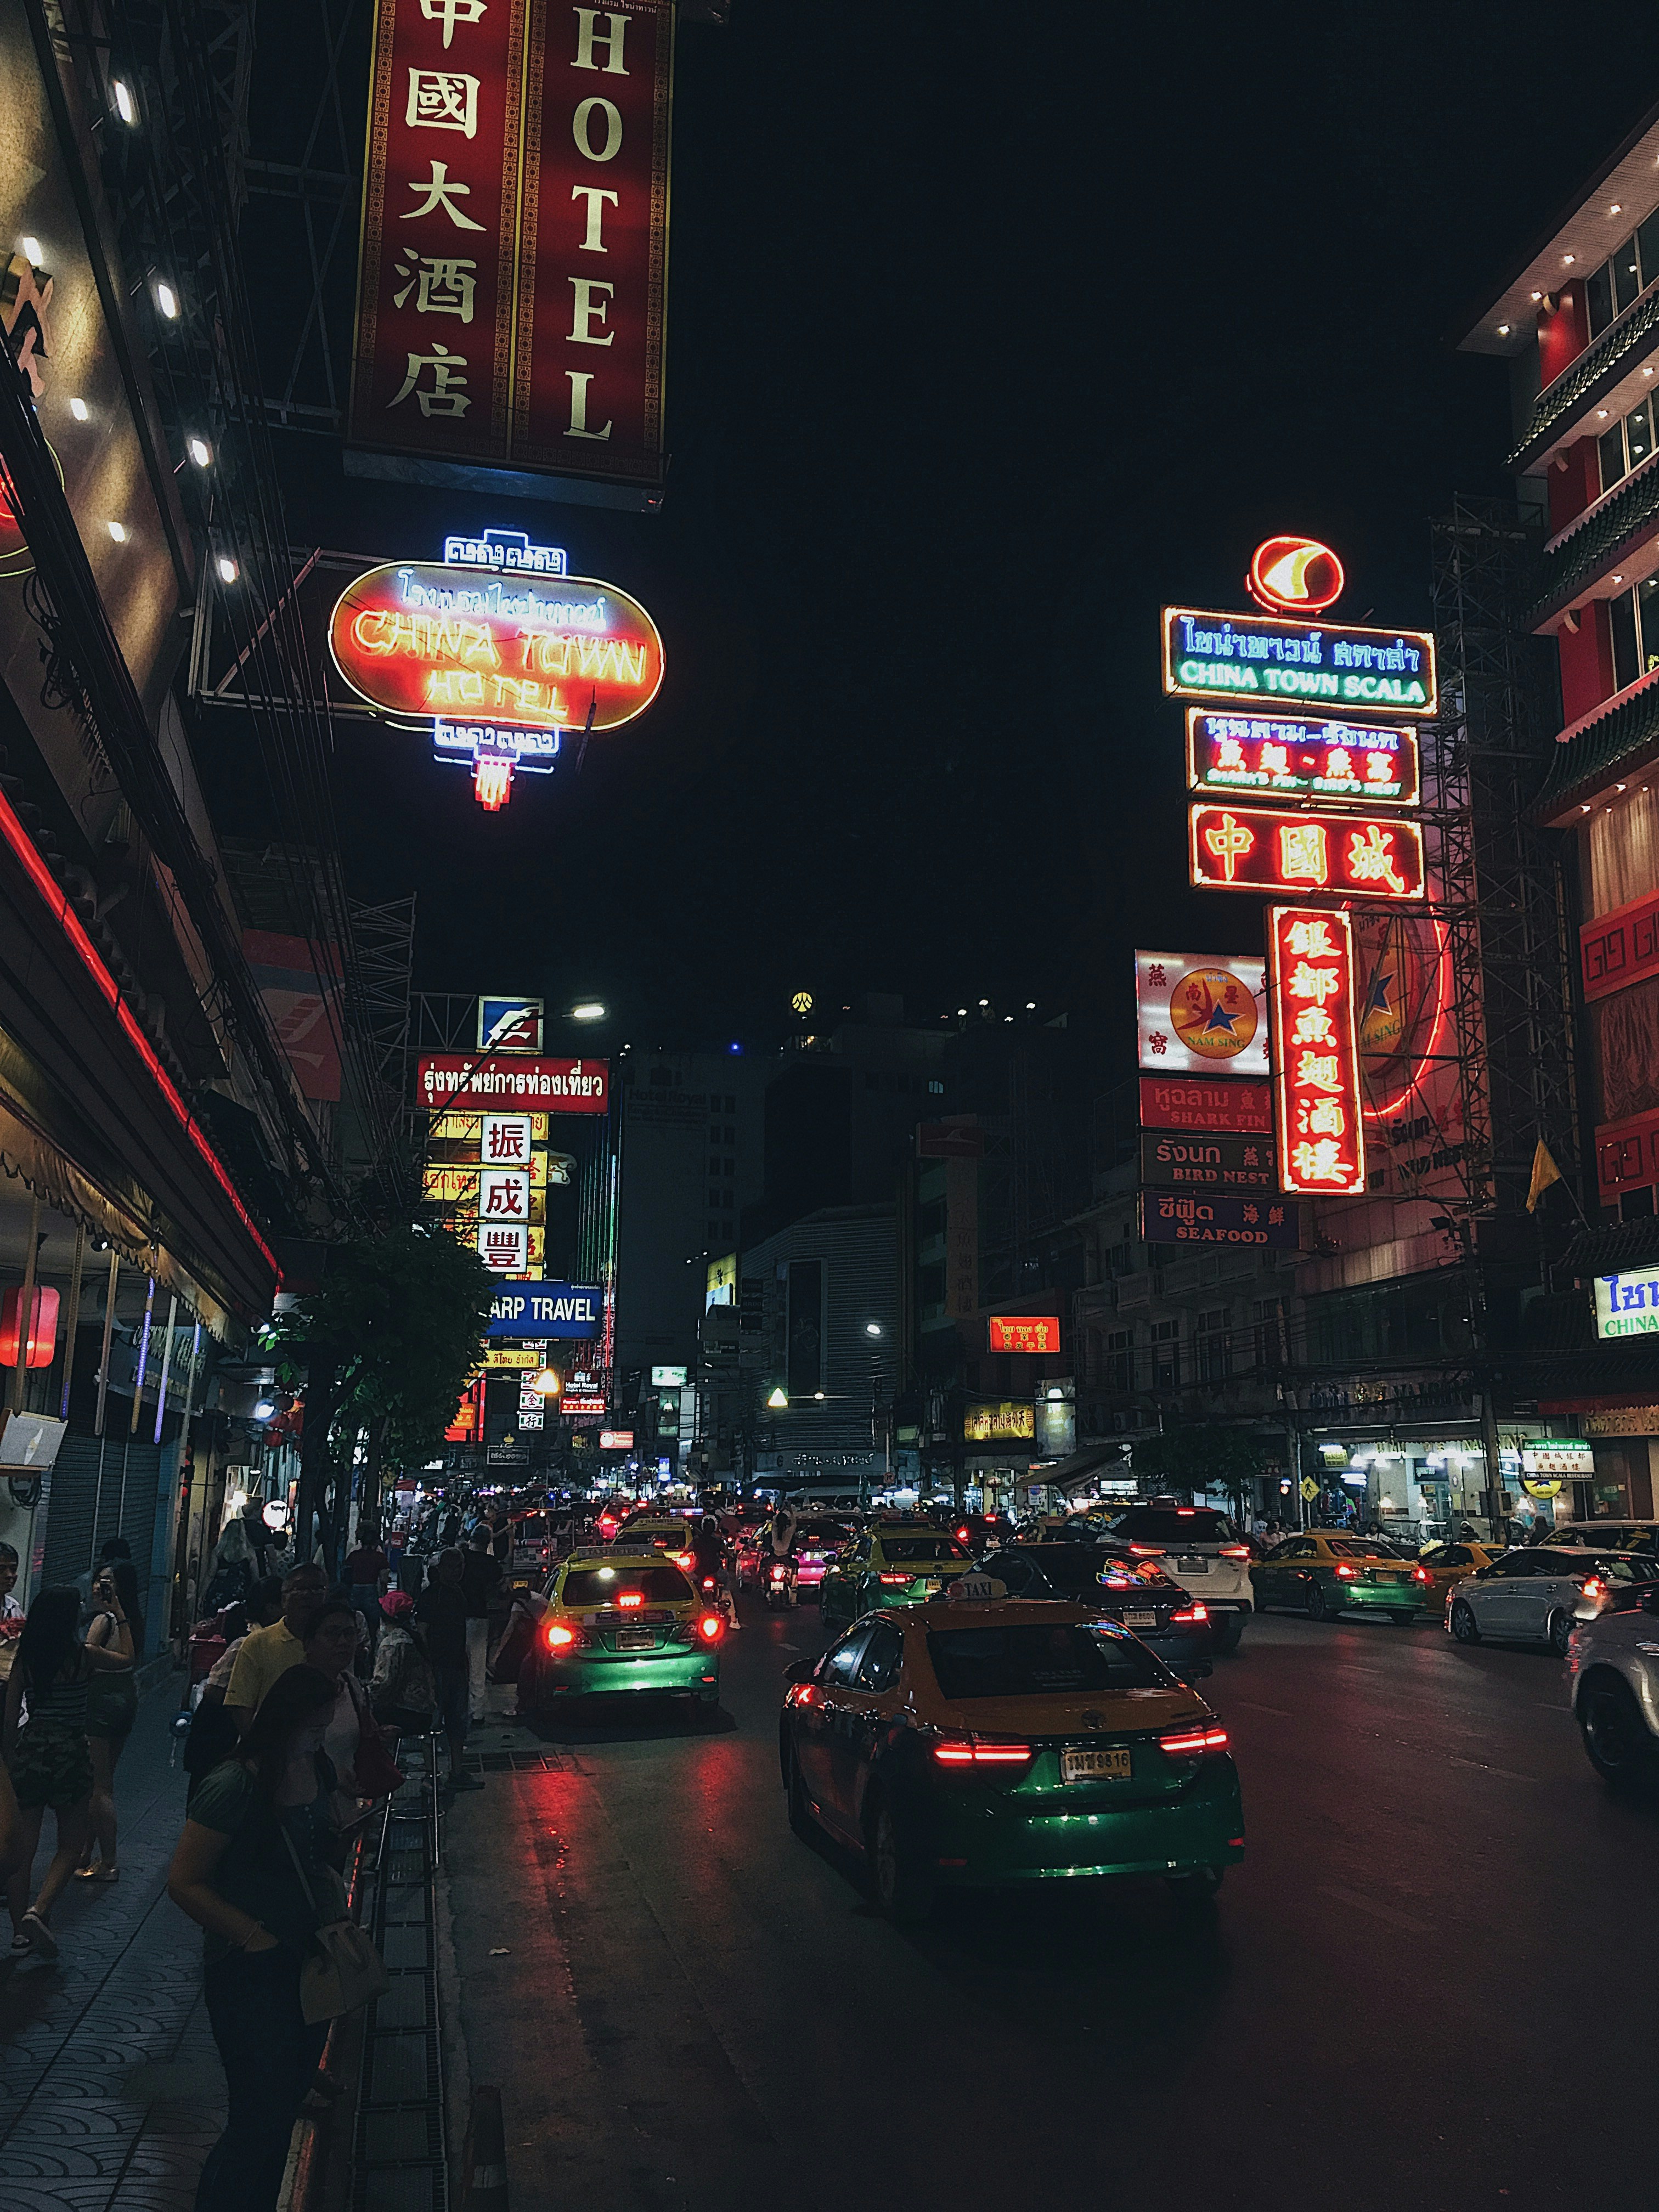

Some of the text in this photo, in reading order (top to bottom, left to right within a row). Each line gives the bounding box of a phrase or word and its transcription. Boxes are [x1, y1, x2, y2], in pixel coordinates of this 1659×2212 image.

[385, 0, 487, 418] 中國大酒店
[563, 6, 633, 441] HOTEL
[352, 610, 647, 685] CHINA TOWN
[1180, 616, 1419, 672] ไชน่าทาวน์ สกาล่า
[426, 669, 569, 717] HOTEL
[1180, 660, 1426, 703] CHINA TOWN SCALA
[1205, 812, 1404, 893] 中國城
[1187, 1036, 1245, 1048] NAM SING
[1284, 921, 1354, 1184] 銀都魚翅酒樓
[424, 1059, 603, 1103] รุ่งทรัพย์การท่องเที่ยว
[1154, 1087, 1229, 1112] หูฉลาม
[1170, 1111, 1265, 1127] SHARK FIN
[1156, 1138, 1221, 1164] รังนก
[1172, 1167, 1269, 1184] BIRD NEST
[484, 1123, 525, 1268] 振成豐
[1243, 1203, 1285, 1227] 海鮮
[1176, 1227, 1269, 1244] SEAFOOD
[531, 1297, 596, 1321] TRAVEL
[1605, 1314, 1659, 1336] CHINA
[964, 1582, 992, 1596] TAXI
